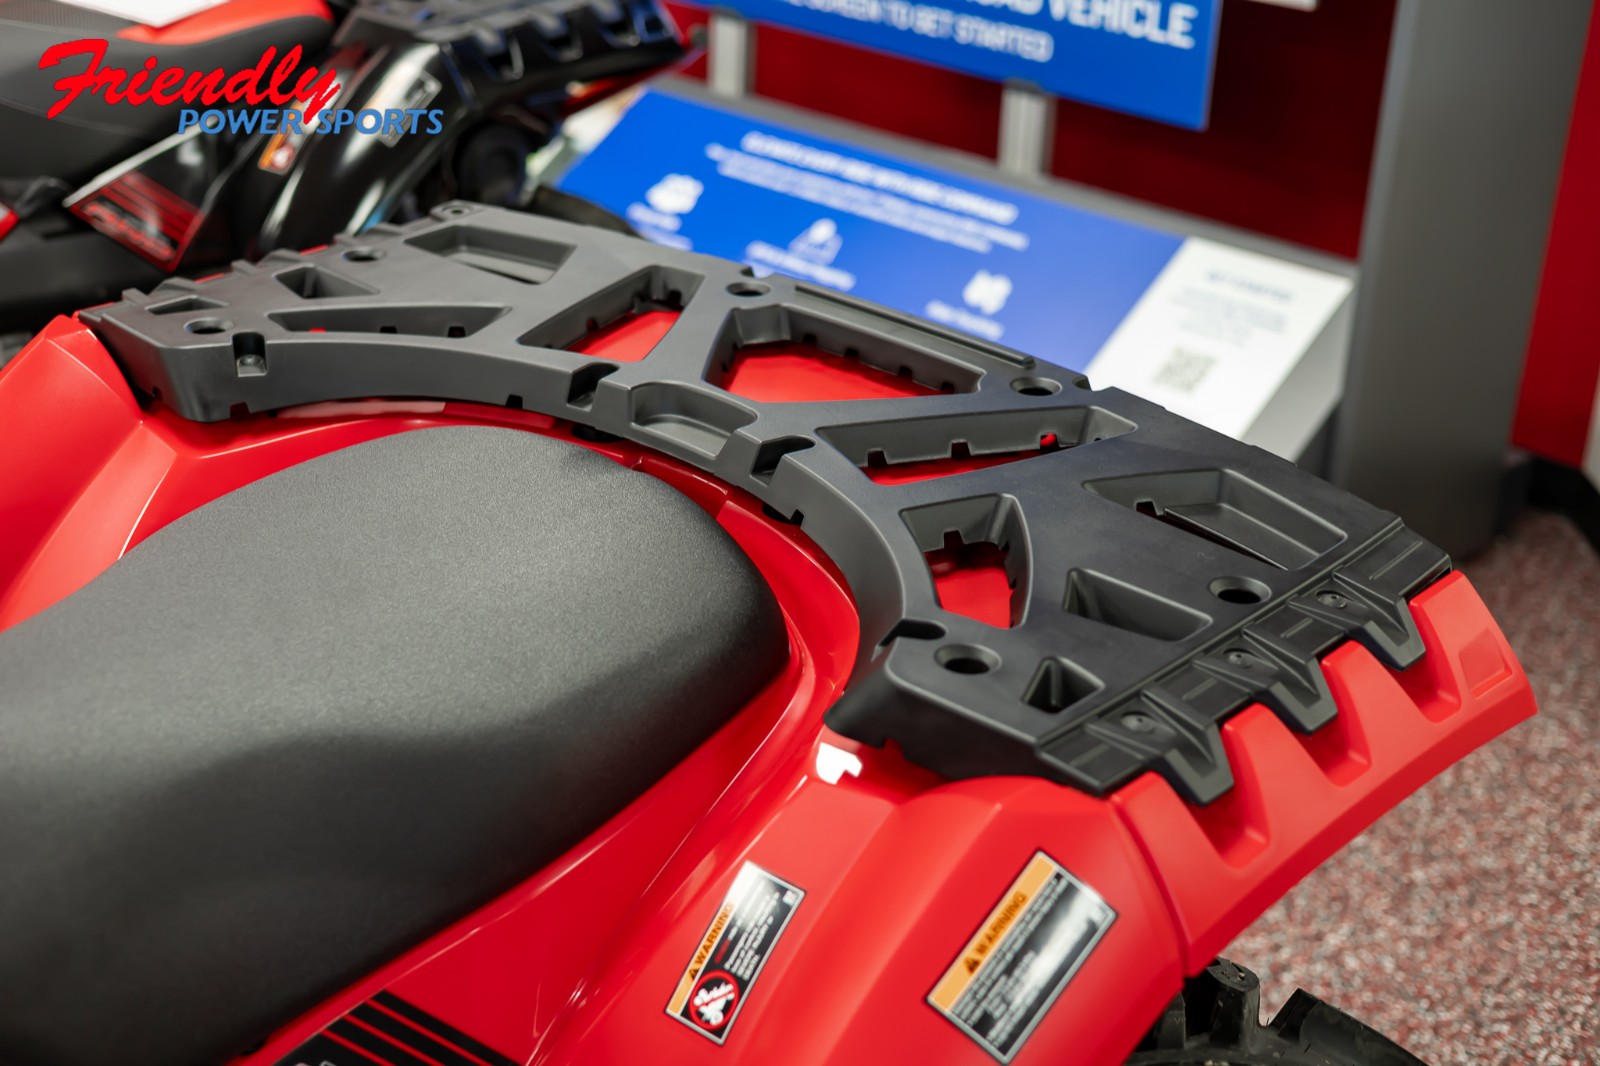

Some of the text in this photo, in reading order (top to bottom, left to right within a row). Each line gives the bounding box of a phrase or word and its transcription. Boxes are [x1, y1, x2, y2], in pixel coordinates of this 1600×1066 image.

[953, 13, 1054, 62] STARTED
[694, 901, 736, 967] WARNING
[975, 889, 1028, 957] WARNING
